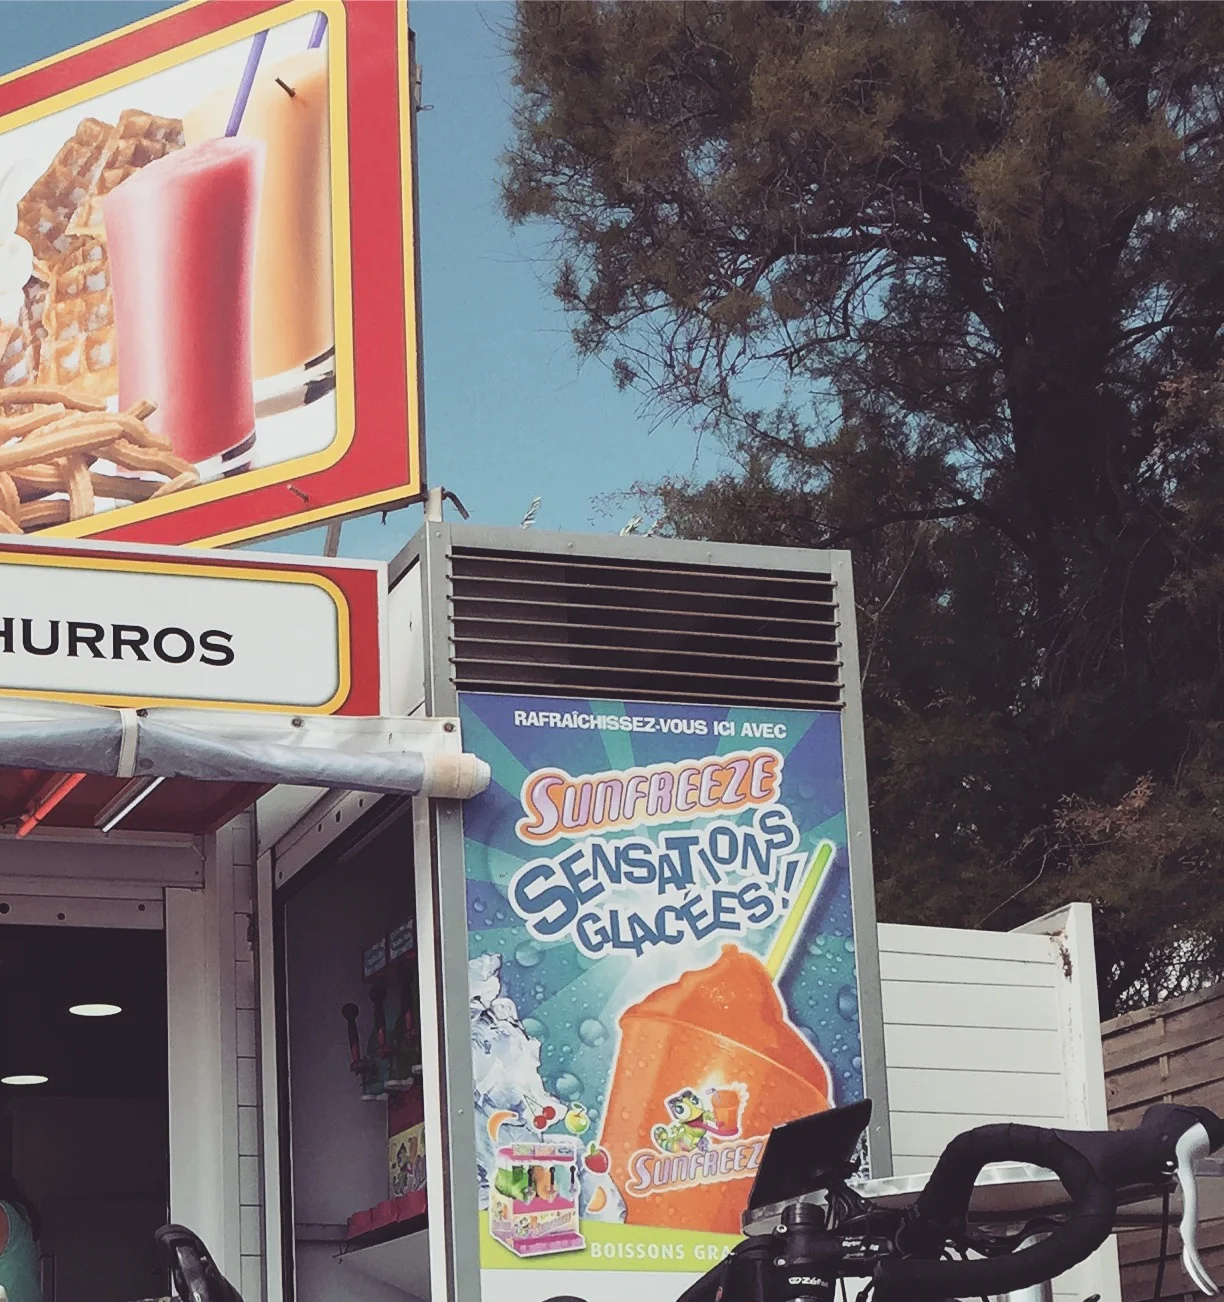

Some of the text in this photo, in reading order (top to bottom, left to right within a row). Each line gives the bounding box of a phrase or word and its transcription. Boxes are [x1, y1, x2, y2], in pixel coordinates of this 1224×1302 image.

[514, 710, 788, 739] RAFRAÎCHISSEZ-VOUS ICI AVEC
[526, 754, 776, 835] SUNFREEZE
[515, 810, 795, 936] SENSATIONS
[633, 1142, 764, 1190] SUNFREEZ
[590, 1241, 686, 1260] BOISSONS
